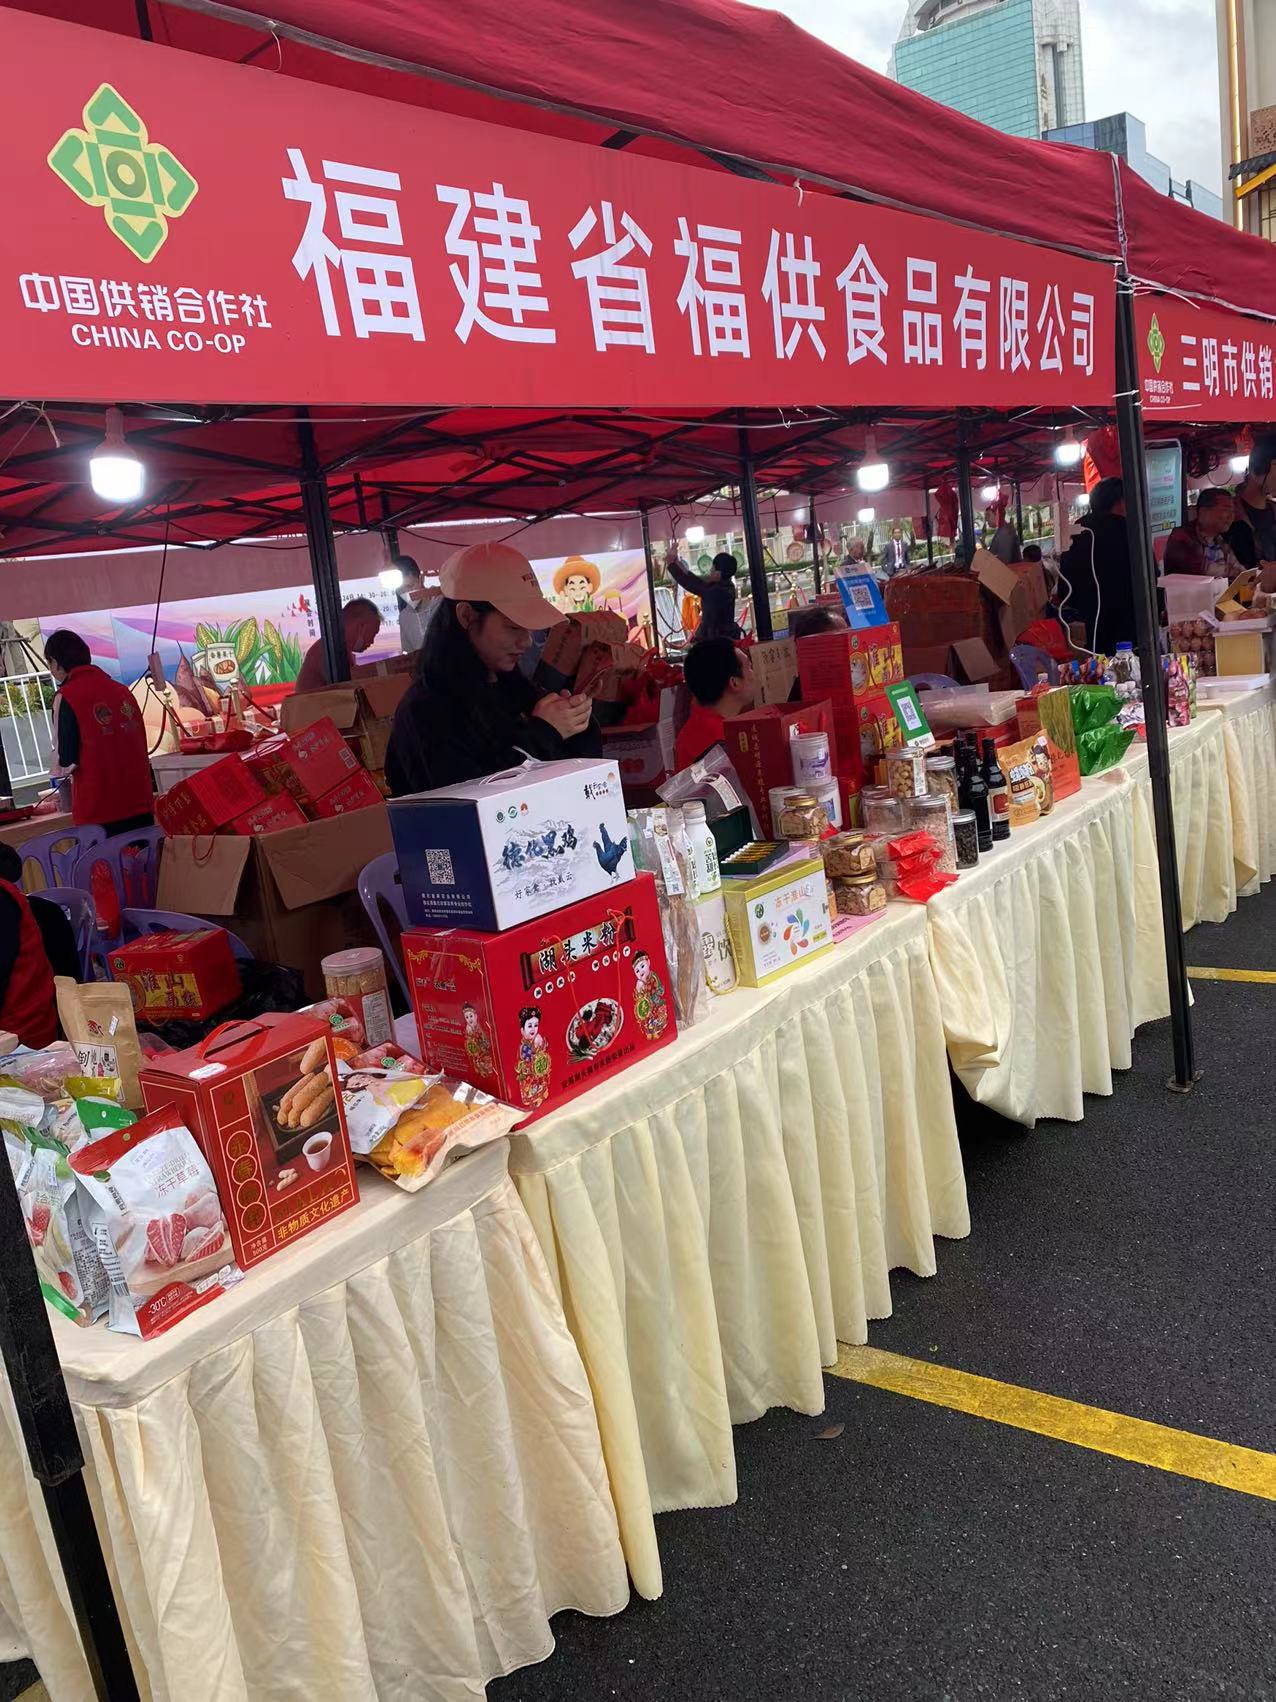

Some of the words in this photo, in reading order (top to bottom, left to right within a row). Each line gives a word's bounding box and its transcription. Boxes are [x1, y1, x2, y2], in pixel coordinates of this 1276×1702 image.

[281, 148, 1096, 377] 福建省福供食品有限公司
[19, 272, 273, 329] 中国供销合作社
[71, 323, 162, 351] CHINA
[167, 331, 247, 354] CO-OP
[539, 921, 617, 975] 湖头米粉
[154, 1163, 200, 1198] 冻干草莓
[277, 1187, 350, 1240] 非物质文化遗产
